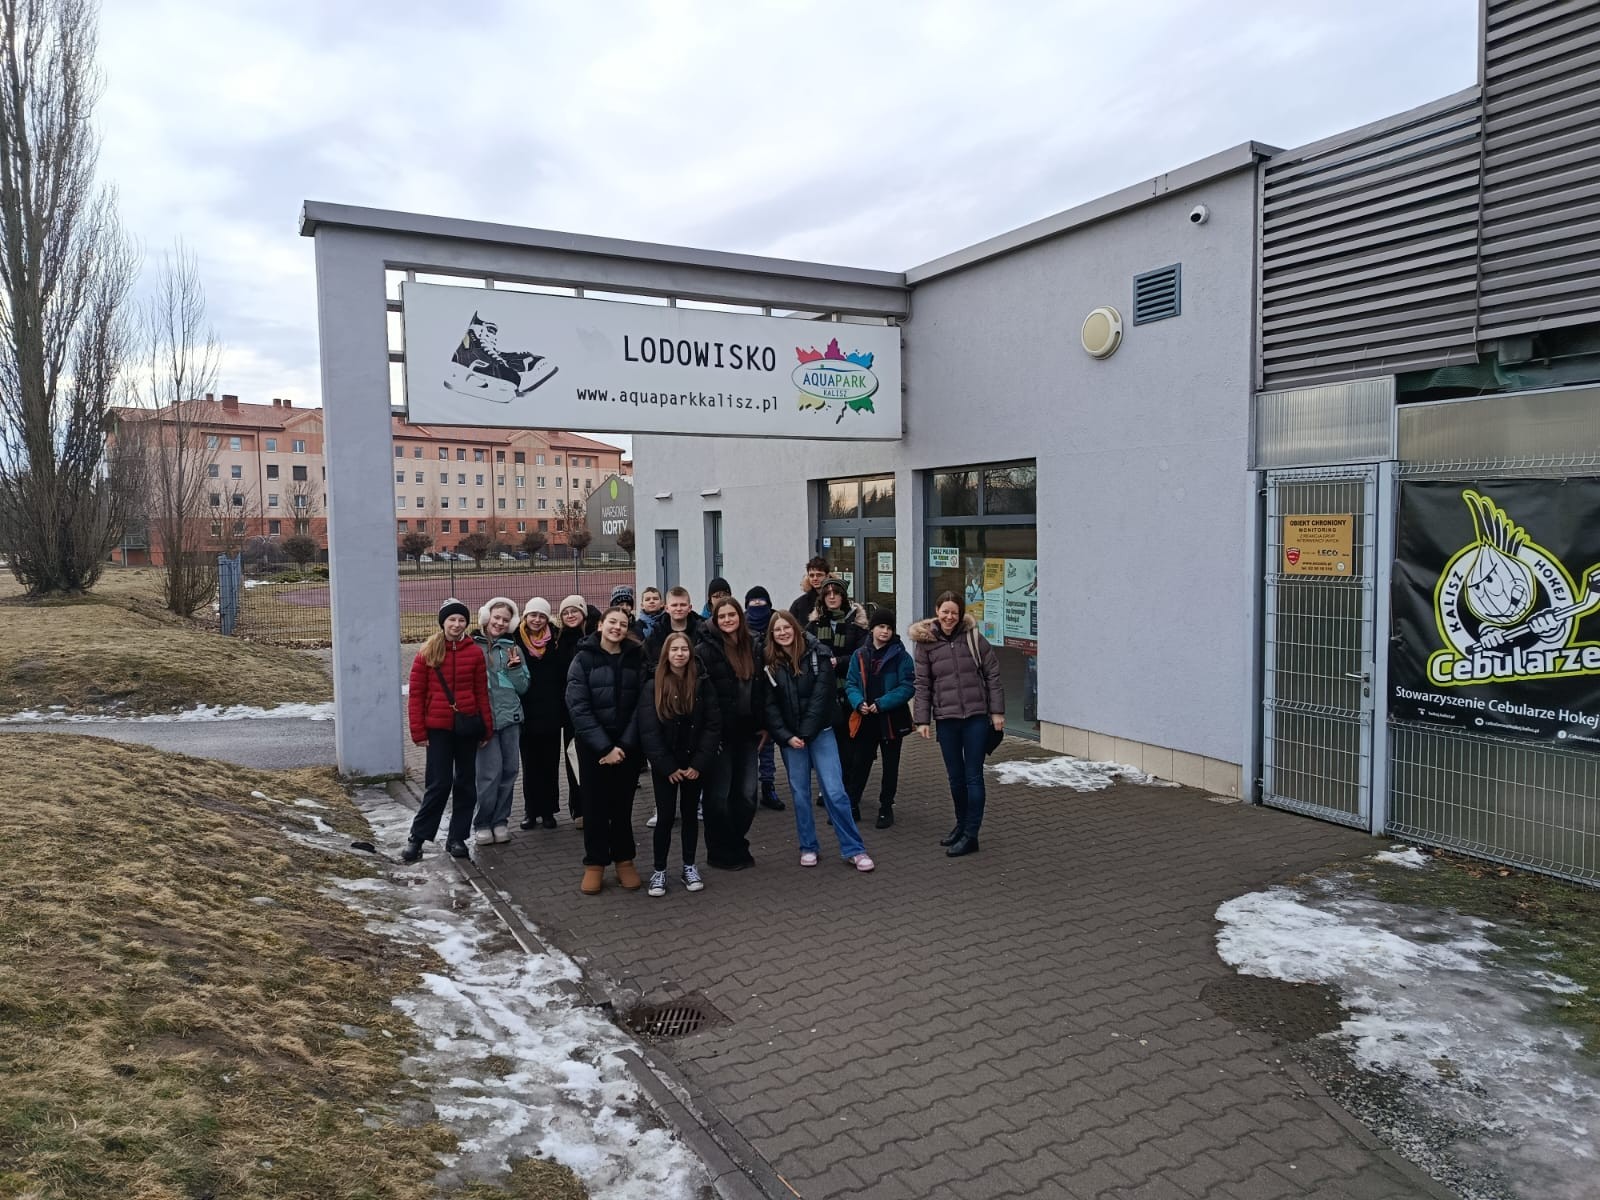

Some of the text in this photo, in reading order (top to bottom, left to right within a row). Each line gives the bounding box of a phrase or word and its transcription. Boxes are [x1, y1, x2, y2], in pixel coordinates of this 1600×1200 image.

[623, 335, 776, 372] LODOWISKO
[803, 372, 866, 388] AQUAPARK
[823, 389, 848, 398] KALISZ
[576, 388, 778, 413] www.aquaparkkalisz.pl
[602, 520, 628, 535] KORTY
[1534, 559, 1567, 602] HOKEJ
[1444, 570, 1464, 634] KALISZ
[1432, 646, 1600, 682] Cebularze
[1395, 686, 1486, 710] Stowarzyszenie
[1488, 700, 1556, 720] Cebularze
